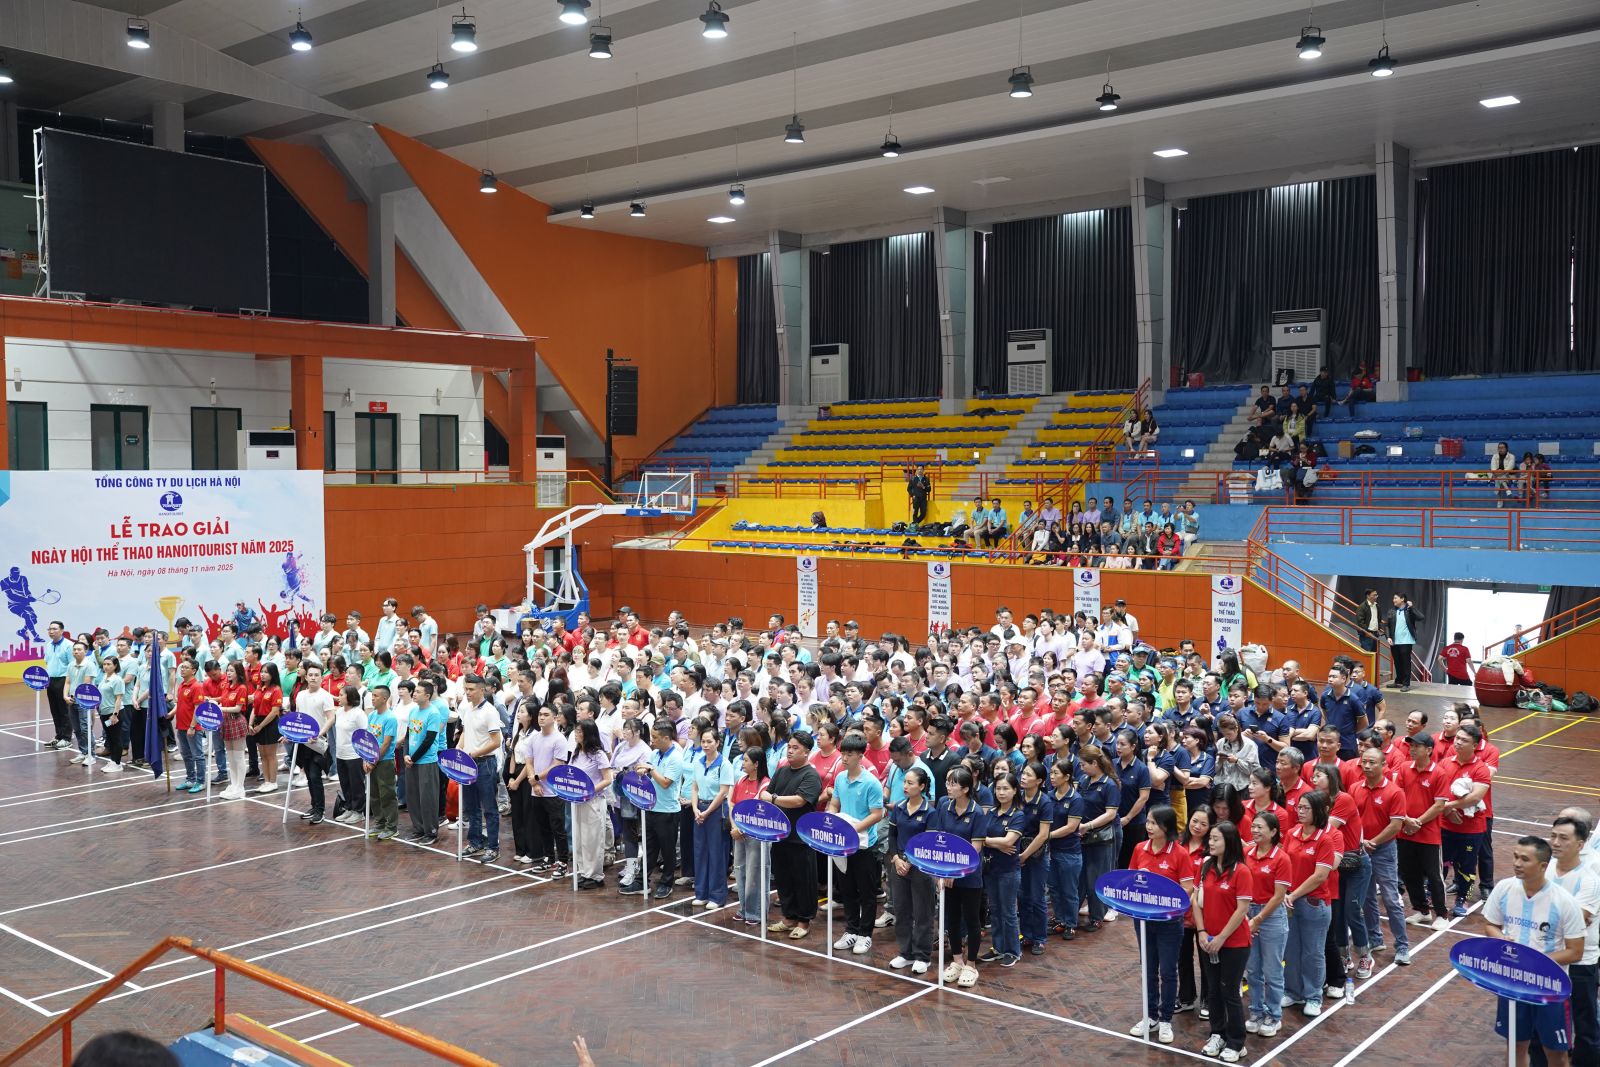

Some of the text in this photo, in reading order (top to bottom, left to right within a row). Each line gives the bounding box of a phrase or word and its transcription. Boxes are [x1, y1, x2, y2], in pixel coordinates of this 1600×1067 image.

[95, 474, 241, 489] TỔNG CÔNG TY DU LỊCH HÀ NỘI
[110, 516, 229, 538] LỄ TRAO GIẢI
[31, 540, 294, 566] NGÀY HỘI THỂ THAO HANOITOURIST NĂM 2025
[137, 568, 155, 577] ngày
[168, 566, 188, 575] tháng
[811, 828, 845, 846] TRỌNG TÀI
[914, 847, 970, 865] KHÁCH SẠN HÒA BÌNH
[1103, 887, 1115, 898] CÔNG
[1116, 889, 1122, 898] TY
[1122, 888, 1129, 900] CỔ
[1129, 889, 1142, 902] PHẦN
[1159, 896, 1171, 906] LONG
[1172, 898, 1182, 908] GTC
[1458, 954, 1473, 968] CÔNG
[1474, 958, 1480, 968] TY
[1481, 956, 1488, 971] CỔ
[1488, 960, 1502, 975] PHẦN
[1503, 966, 1510, 977] DU
[1511, 968, 1523, 982] LỊCH
[1524, 971, 1536, 985] DỊCH
[1537, 975, 1544, 990] VỤ
[1544, 976, 1552, 990] HÀ
[1552, 979, 1562, 993] NỘI
[1555, 1029, 1568, 1043] 11
